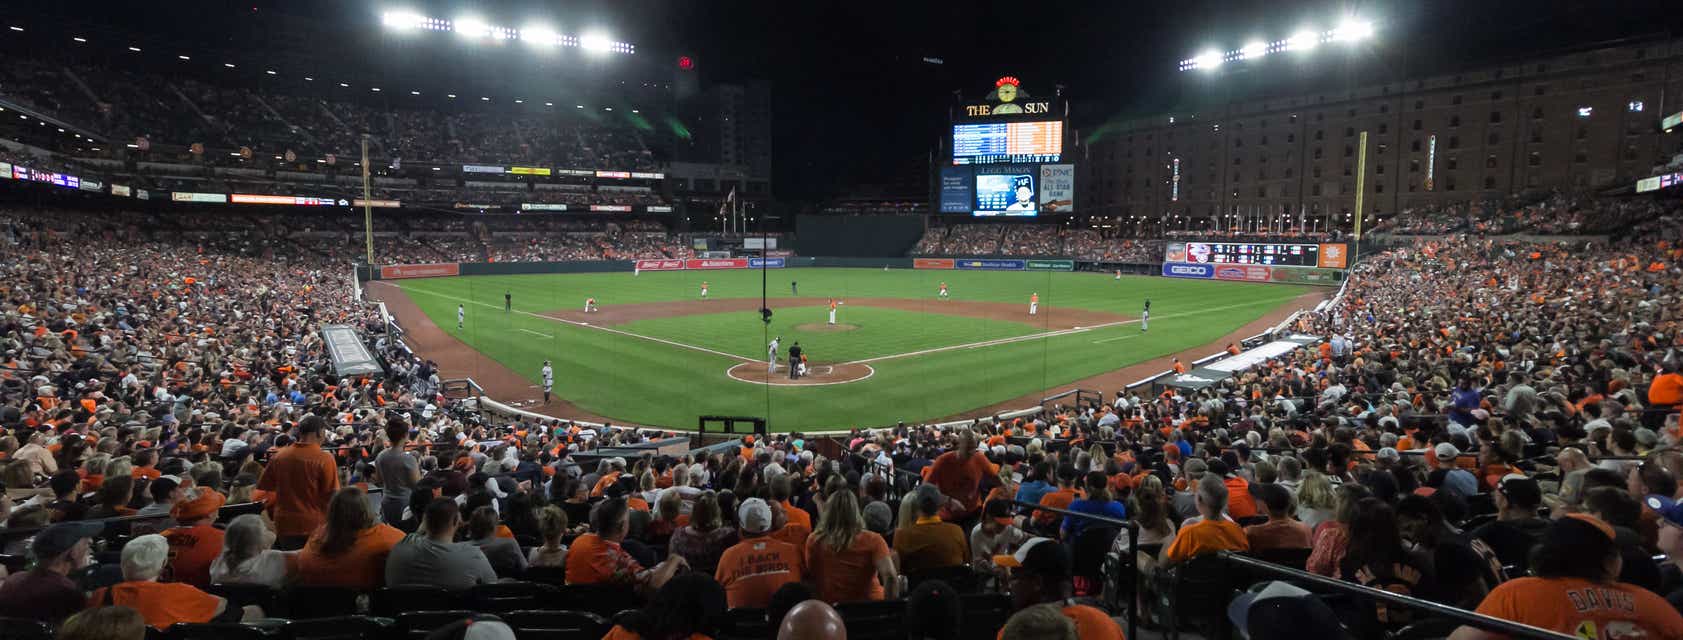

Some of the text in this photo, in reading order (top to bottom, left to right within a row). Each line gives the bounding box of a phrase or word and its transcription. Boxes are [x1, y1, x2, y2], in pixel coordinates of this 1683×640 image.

[967, 103, 1049, 116] THE SUN
[1171, 265, 1207, 275] GEICO
[1567, 588, 1634, 612] DAVIS
